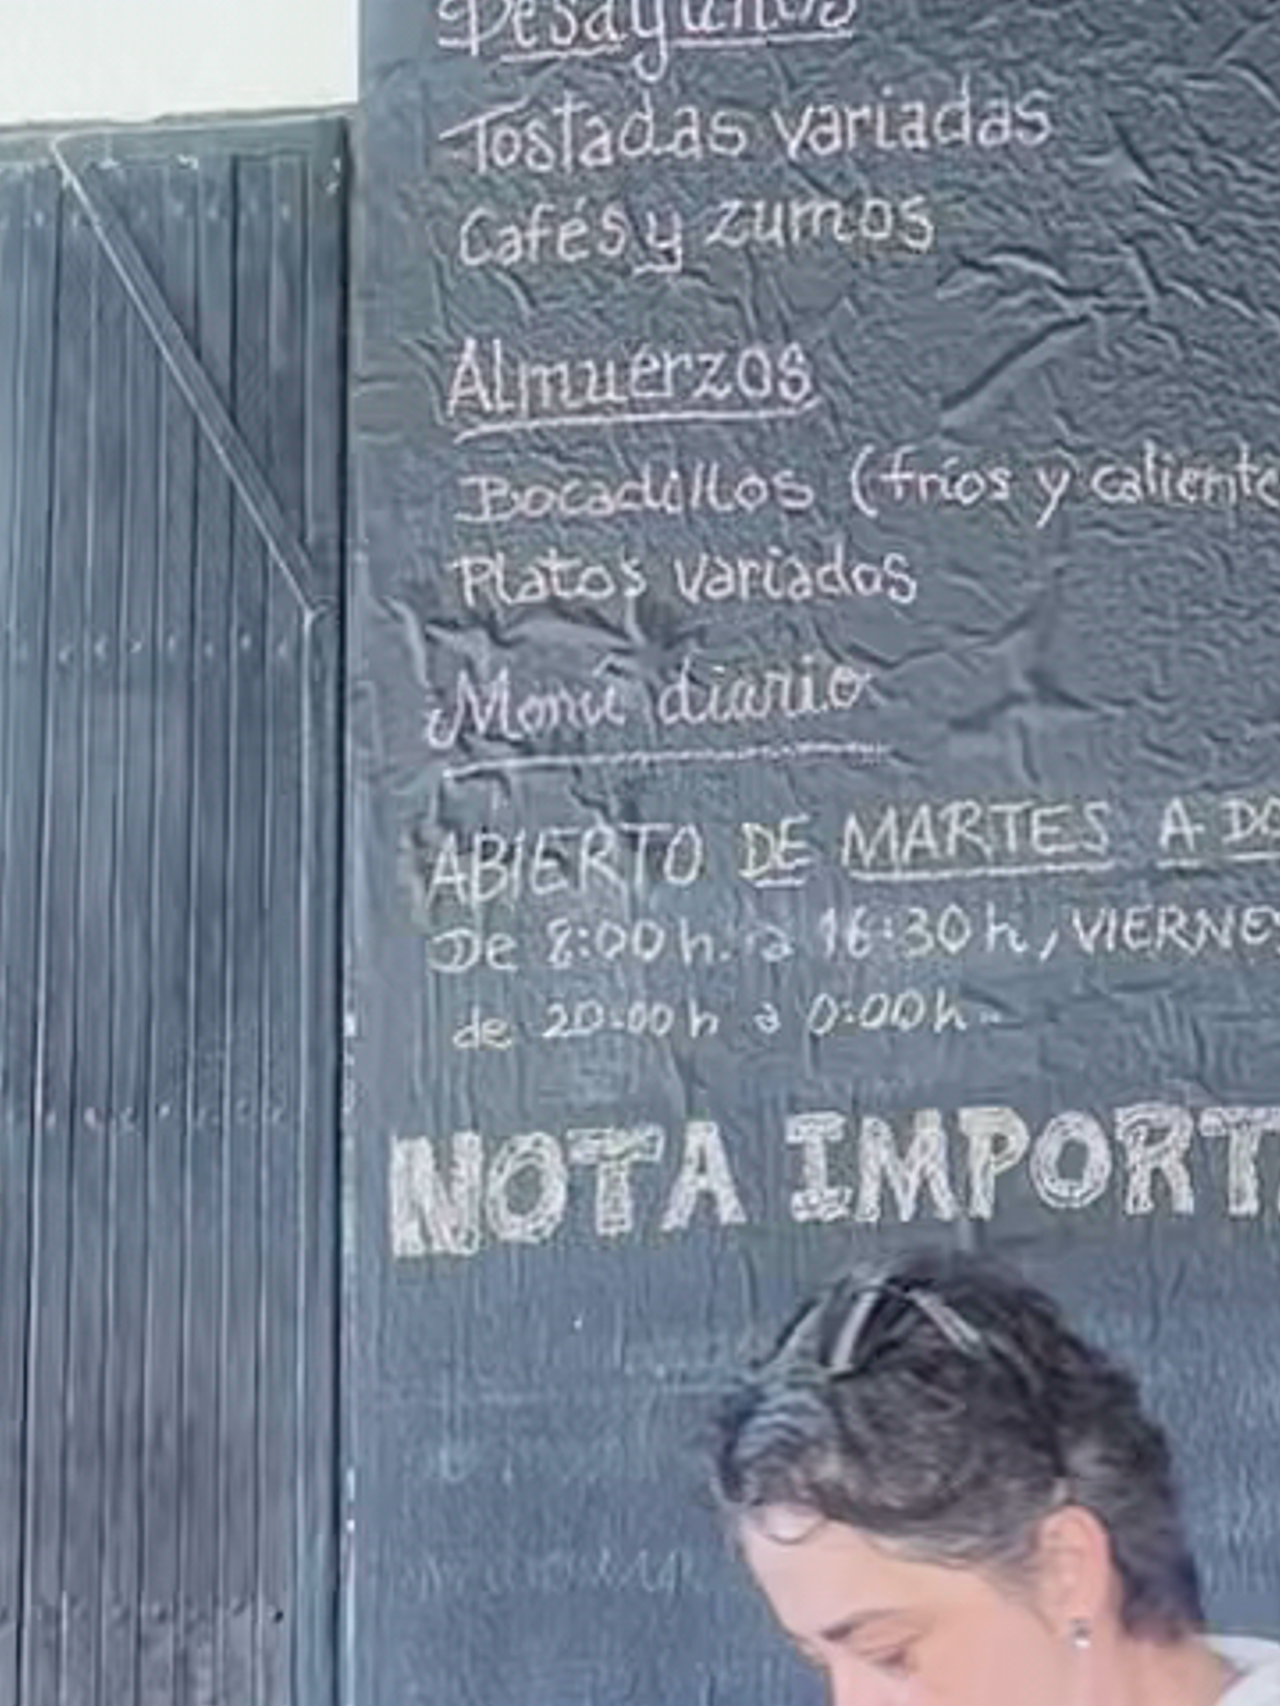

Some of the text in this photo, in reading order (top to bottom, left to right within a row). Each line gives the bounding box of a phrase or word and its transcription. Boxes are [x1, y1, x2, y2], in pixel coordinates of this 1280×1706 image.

[439, 78, 1053, 173] Tostadas variadas
[458, 195, 935, 276] Cafés y zumos
[446, 338, 813, 418] Almuerzos
[454, 462, 815, 522] Bocadillos
[850, 443, 1016, 518] (fríos
[1036, 466, 1071, 529] y
[451, 540, 918, 608] Platos variados
[657, 654, 872, 726] diario
[425, 822, 704, 908] ABIERTO
[738, 813, 812, 884] DE
[840, 799, 1113, 868] MARTES
[1158, 797, 1205, 851] A
[428, 927, 519, 973] De
[546, 918, 665, 968] 8:00
[820, 904, 972, 960] 16:30
[453, 1006, 513, 1049] de
[806, 989, 926, 1036] 0:00
[389, 1119, 746, 1259] NOTA
